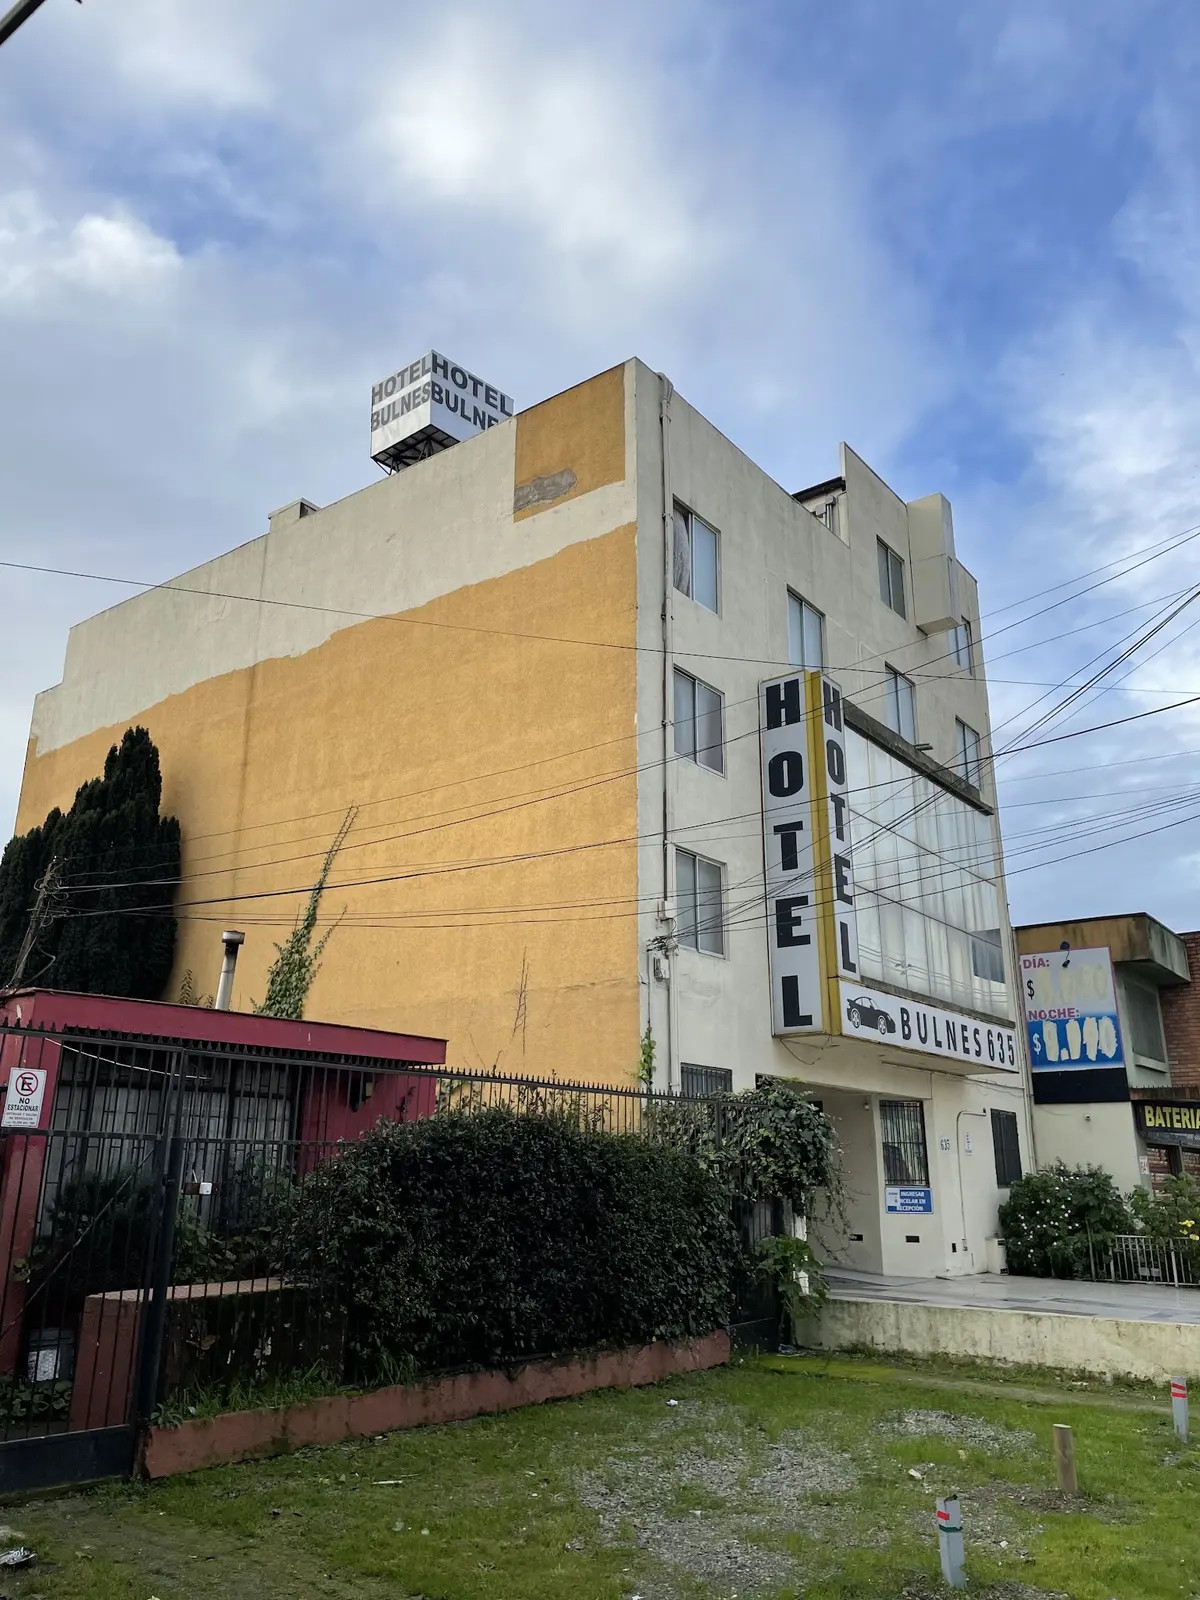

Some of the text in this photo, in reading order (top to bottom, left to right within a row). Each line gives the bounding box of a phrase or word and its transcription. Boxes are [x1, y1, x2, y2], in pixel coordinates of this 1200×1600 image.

[371, 380, 431, 433] BULNES
[372, 355, 431, 406] HOTEL
[431, 352, 513, 417] HOTEL
[765, 678, 813, 1028] HOTEL
[822, 680, 857, 974] HOTEL
[1022, 955, 1050, 969] DÍA:
[900, 1006, 982, 1058] BULNES
[987, 1028, 1016, 1067] 635
[1028, 1007, 1080, 1021] NOCHE:
[7, 1104, 38, 1112] ESTACIONAR
